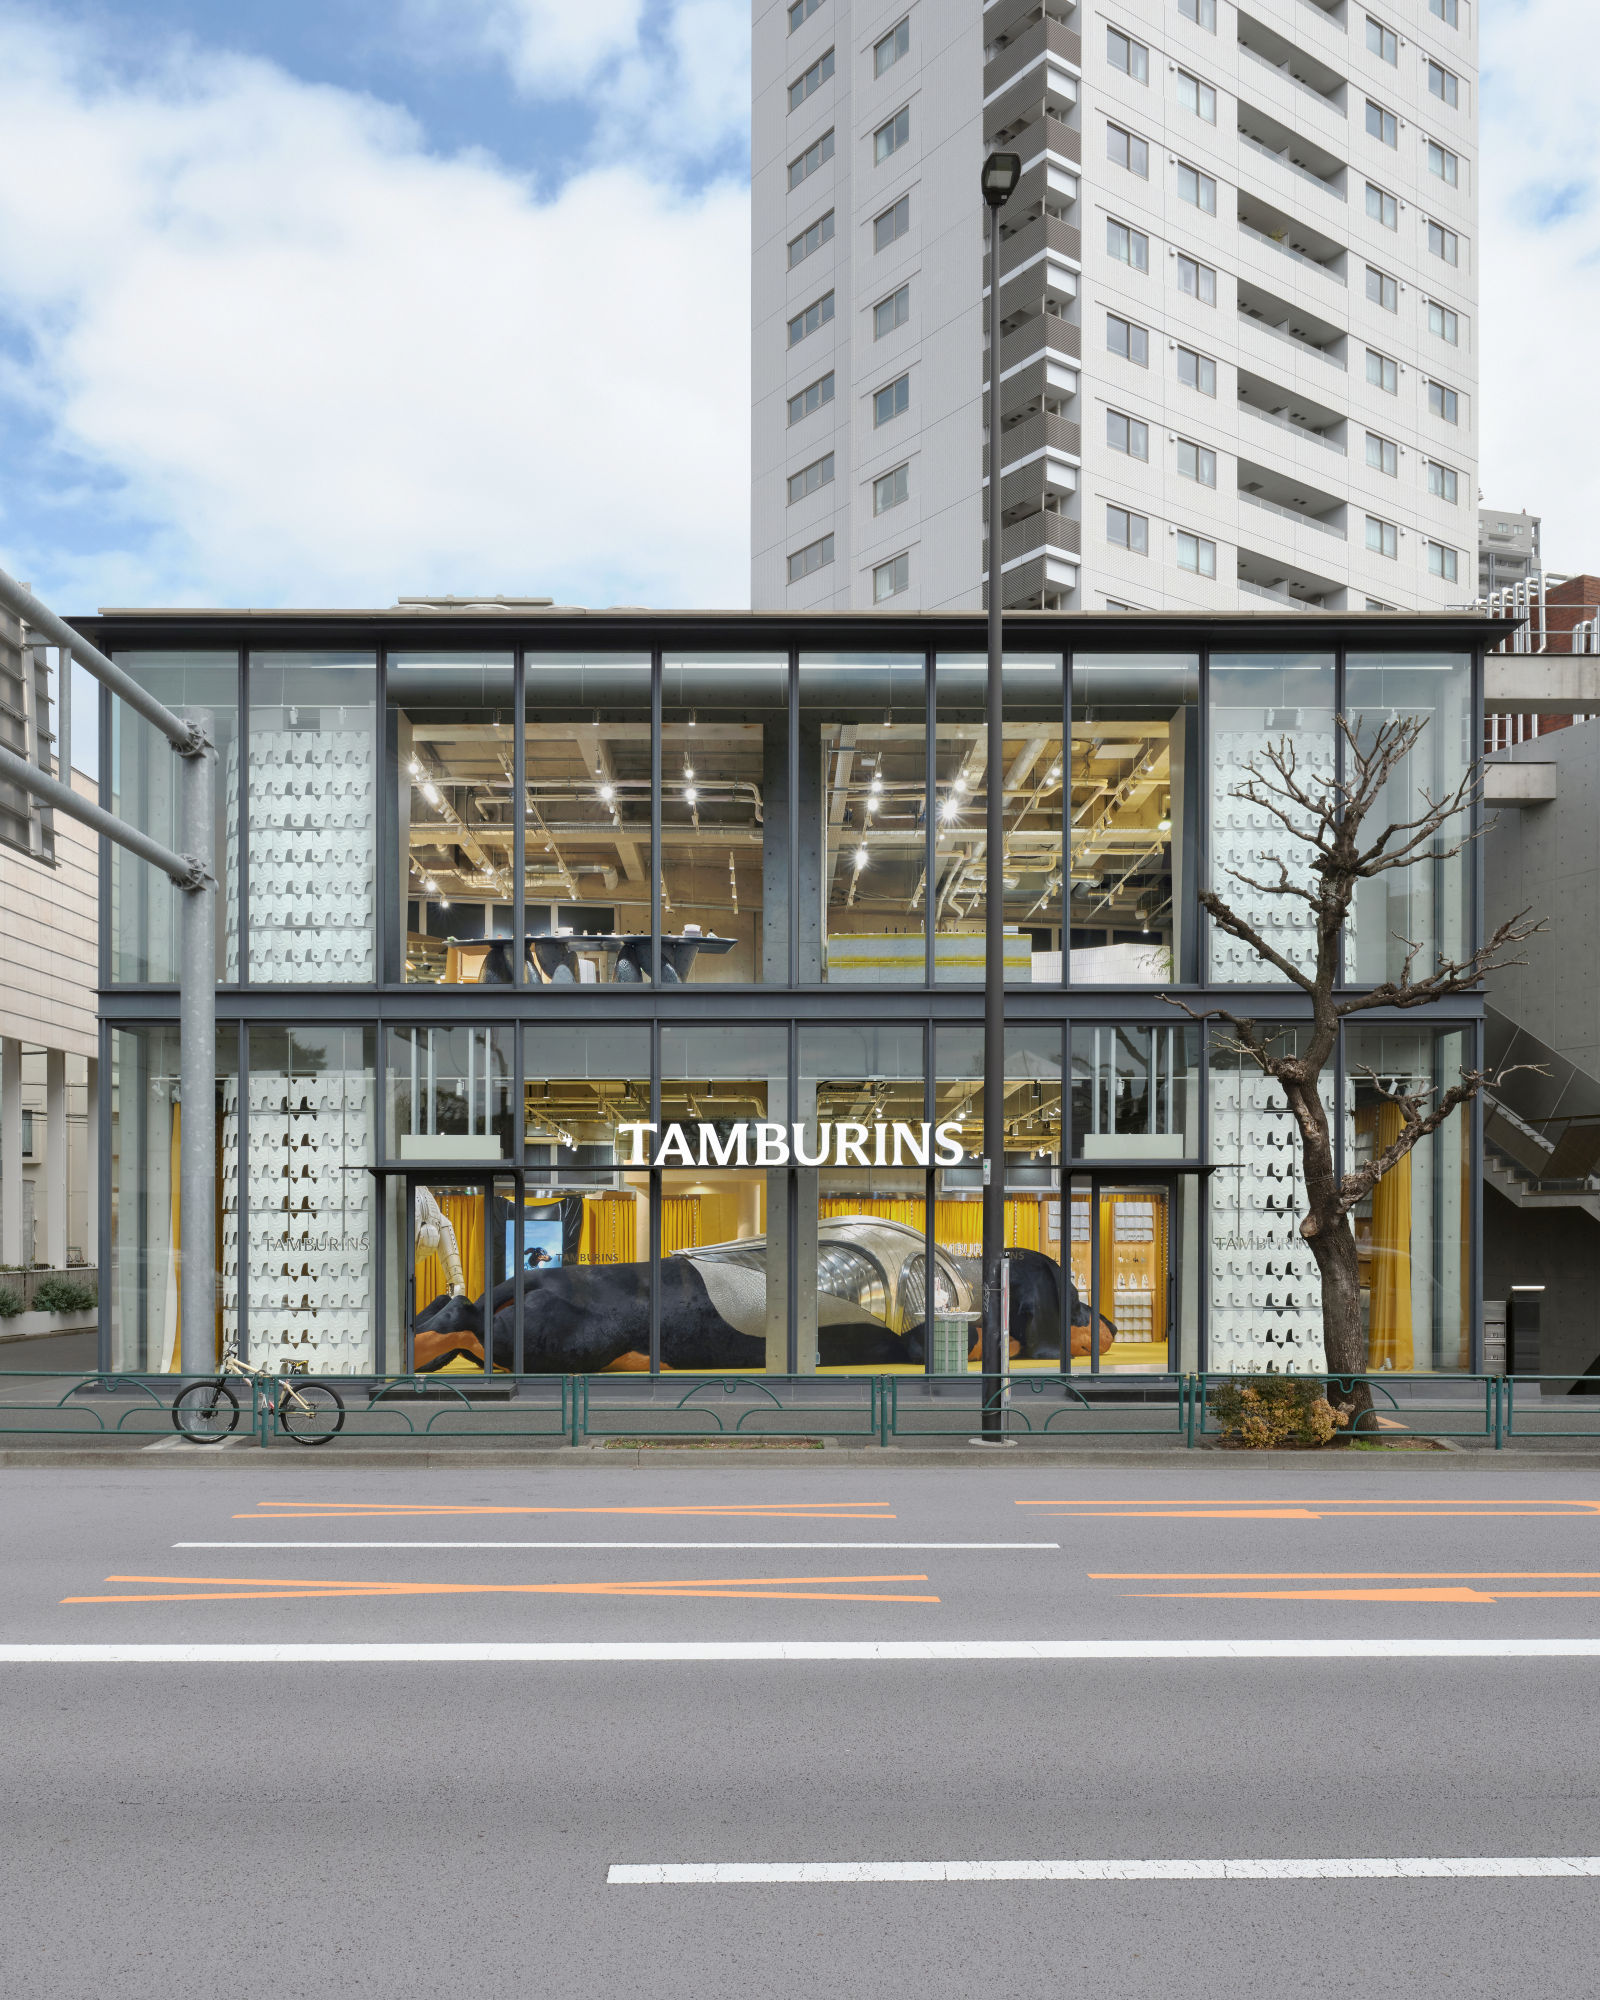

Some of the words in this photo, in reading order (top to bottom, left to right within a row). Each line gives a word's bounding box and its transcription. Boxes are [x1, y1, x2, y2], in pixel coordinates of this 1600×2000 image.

[619, 1123, 964, 1166] TAMBURINS
[263, 1238, 369, 1251] TAMBURINS
[1214, 1237, 1311, 1250] TAMBURIN
